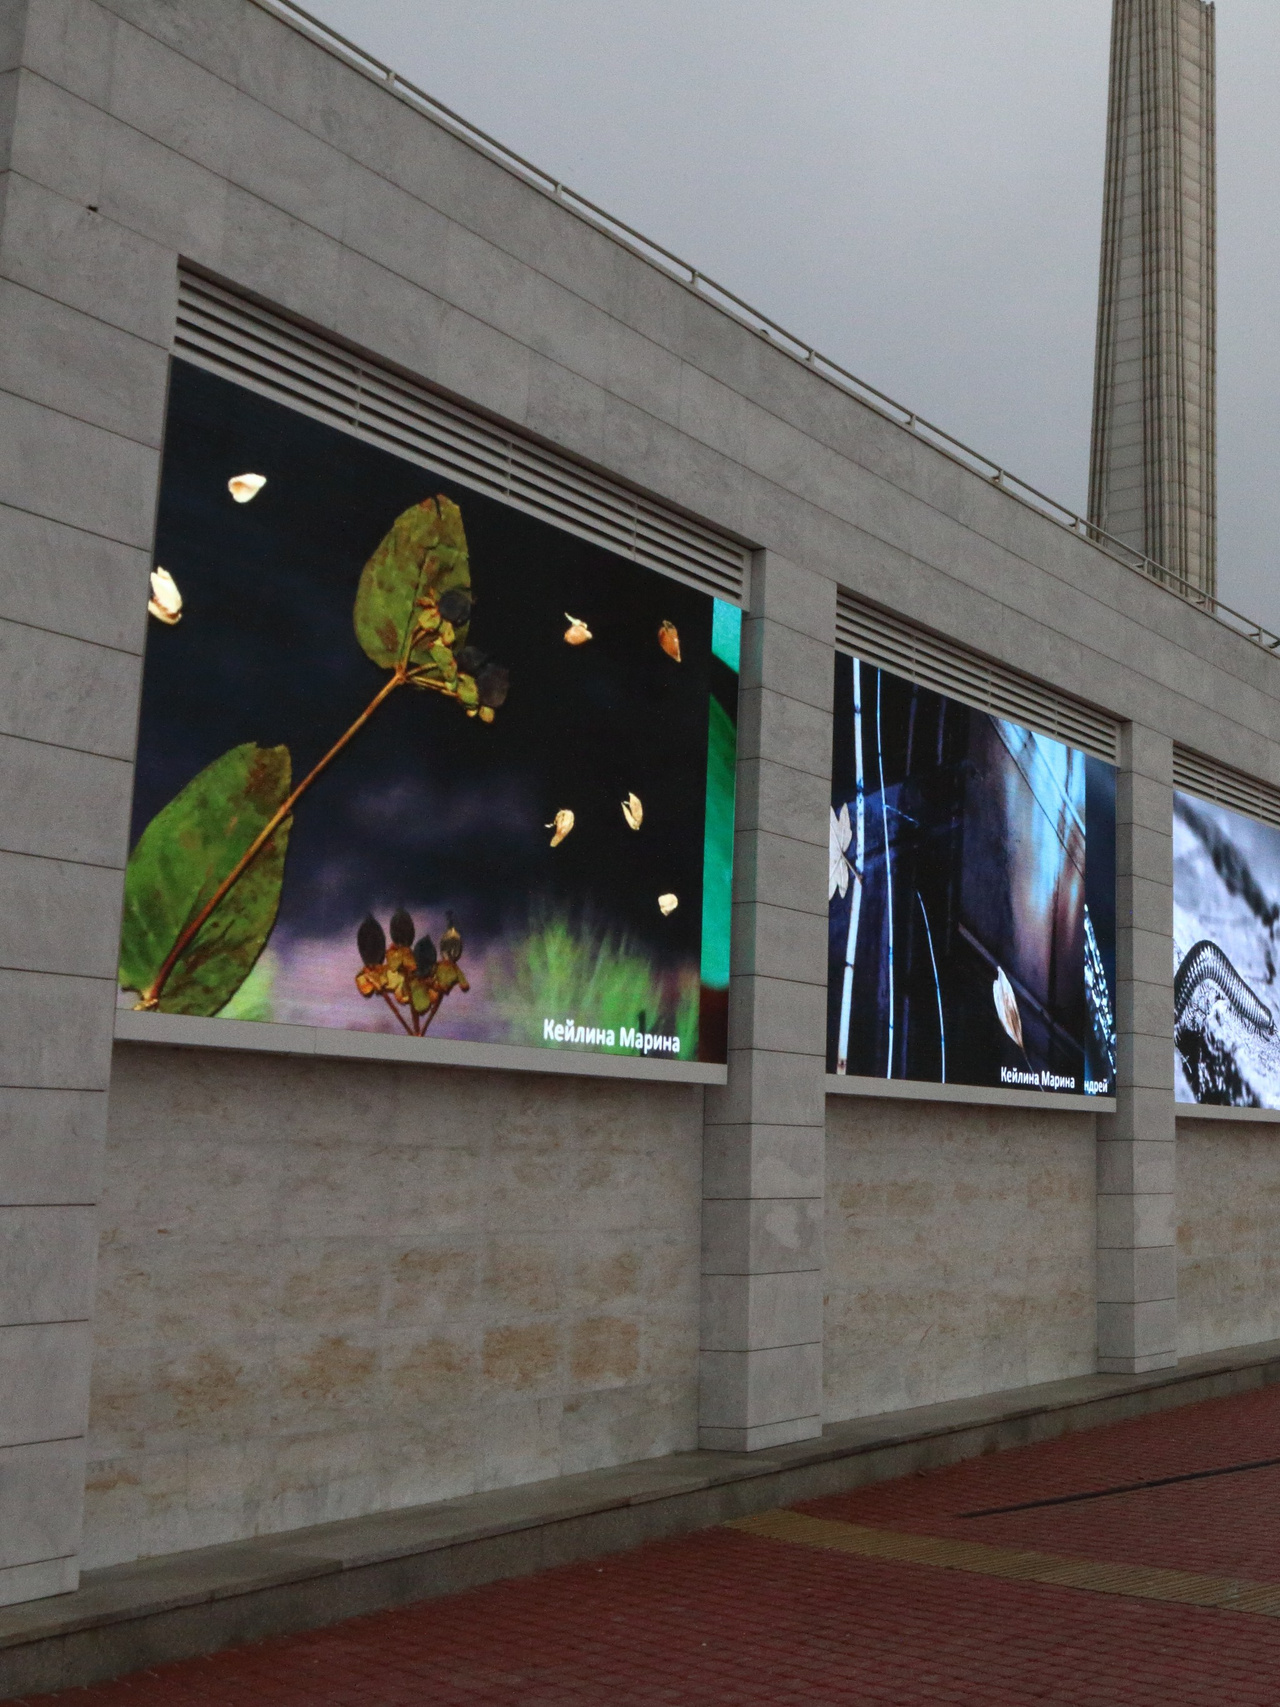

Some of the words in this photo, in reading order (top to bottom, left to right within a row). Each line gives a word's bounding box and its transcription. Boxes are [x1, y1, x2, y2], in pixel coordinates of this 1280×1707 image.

[543, 1018, 616, 1047] Кейлина
[619, 1026, 681, 1053] Марина
[1000, 1066, 1040, 1086] Кейлина
[1041, 1070, 1076, 1090] Марина
